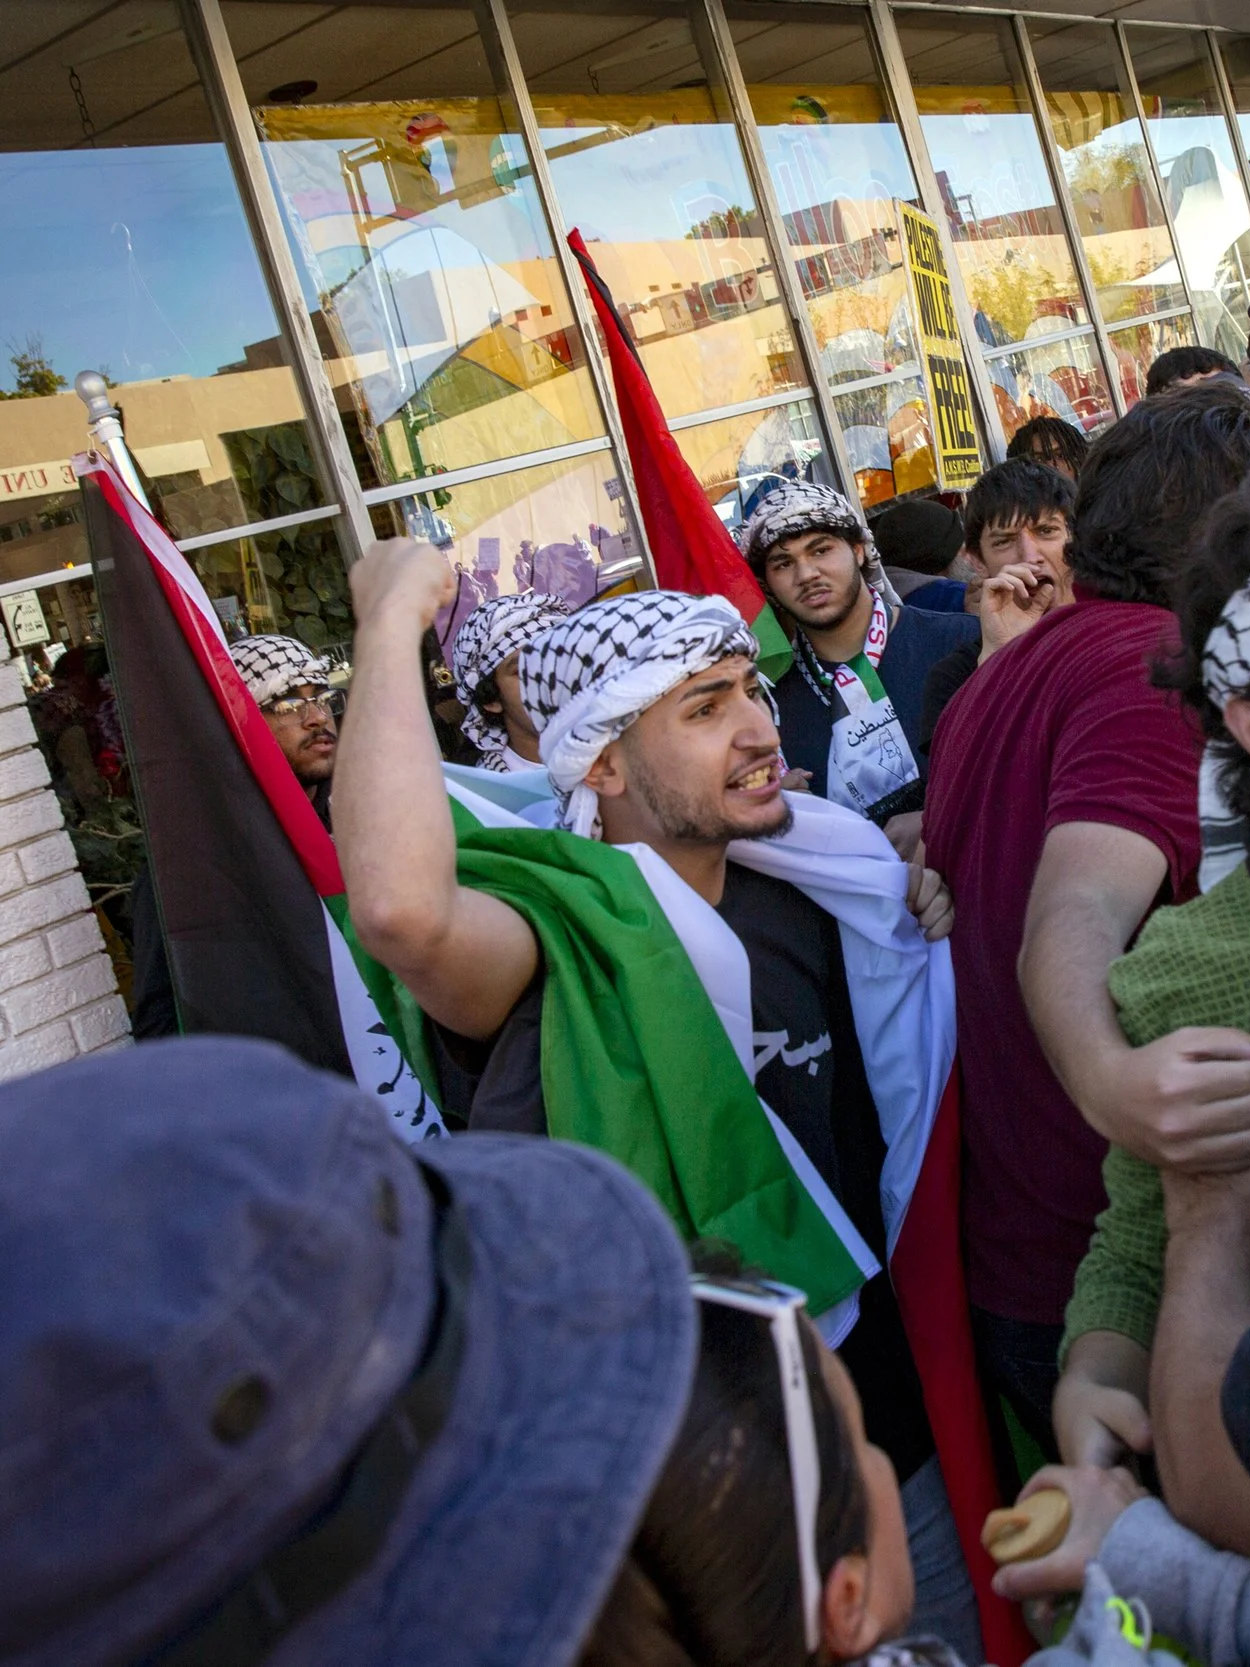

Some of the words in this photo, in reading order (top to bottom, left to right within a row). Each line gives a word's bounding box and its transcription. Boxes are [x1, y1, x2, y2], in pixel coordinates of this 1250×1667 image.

[903, 213, 947, 279] PALESTINE
[913, 270, 946, 337] WILL
[940, 280, 957, 340] BE
[847, 704, 898, 747] فلسطين
